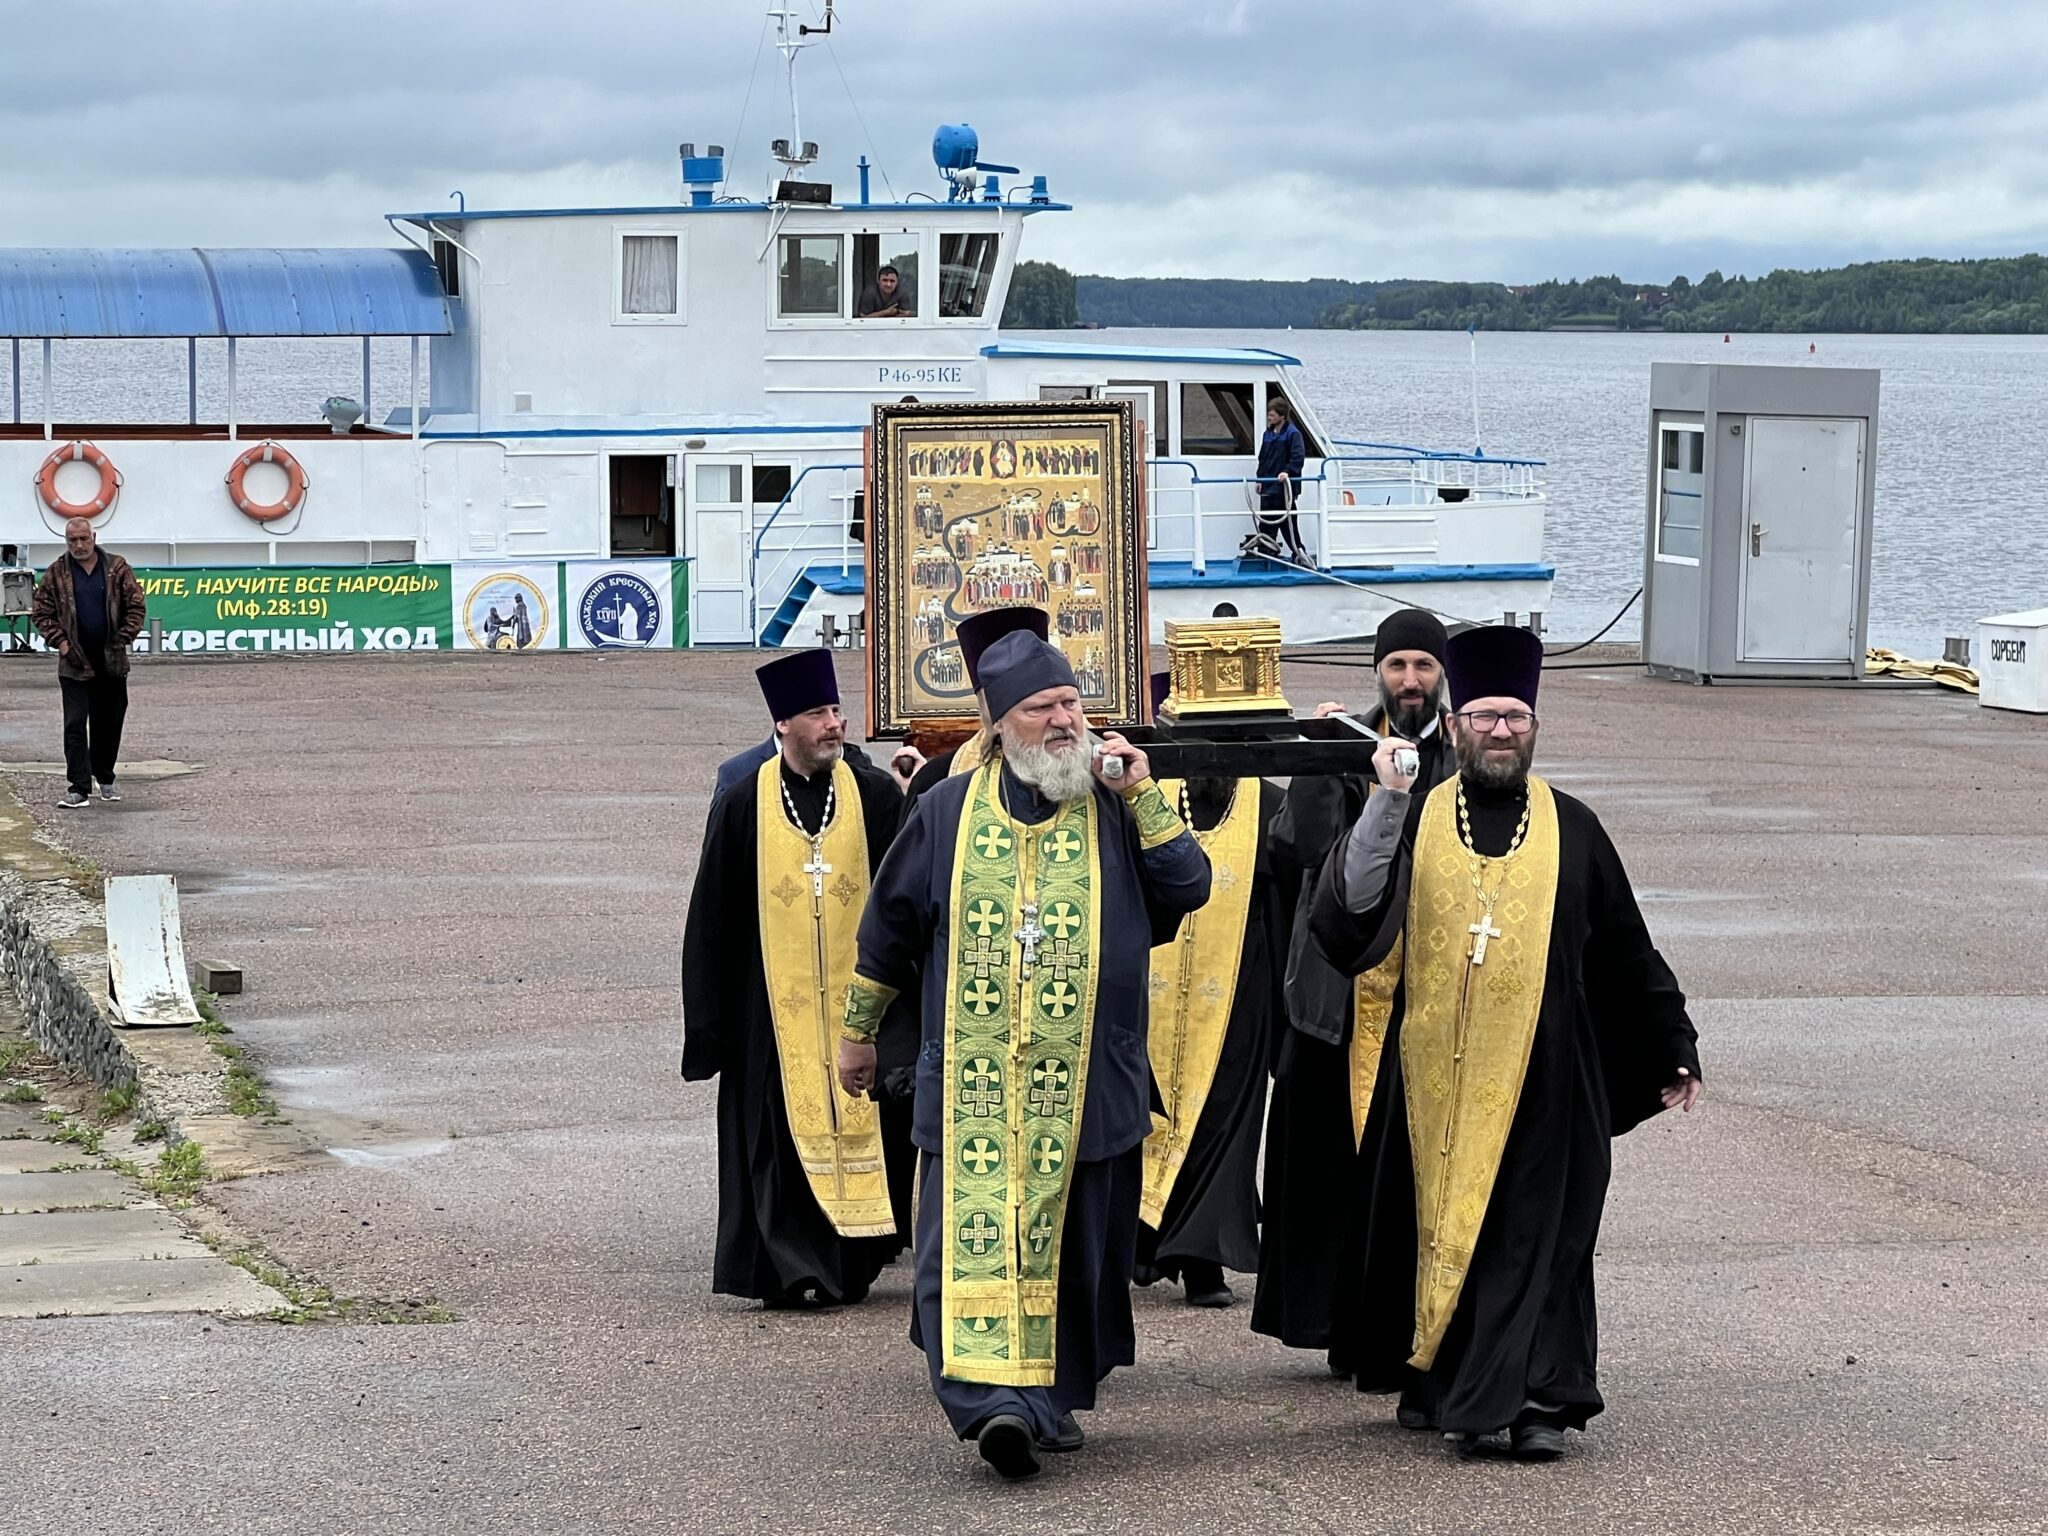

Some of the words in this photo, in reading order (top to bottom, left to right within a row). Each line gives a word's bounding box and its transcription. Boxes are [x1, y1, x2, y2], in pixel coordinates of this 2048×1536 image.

[196, 577, 290, 595] НАУЧИТЕ
[295, 576, 332, 594] ВСЕ
[336, 575, 439, 596] НАРОДЫ»
[216, 597, 328, 620] (Мф.28:19)
[645, 611, 657, 629] ХОД
[161, 620, 354, 651] КРЕСТНЫЙ
[361, 626, 439, 650] ХОД
[1991, 639, 2026, 664] СОРБЕНТ
